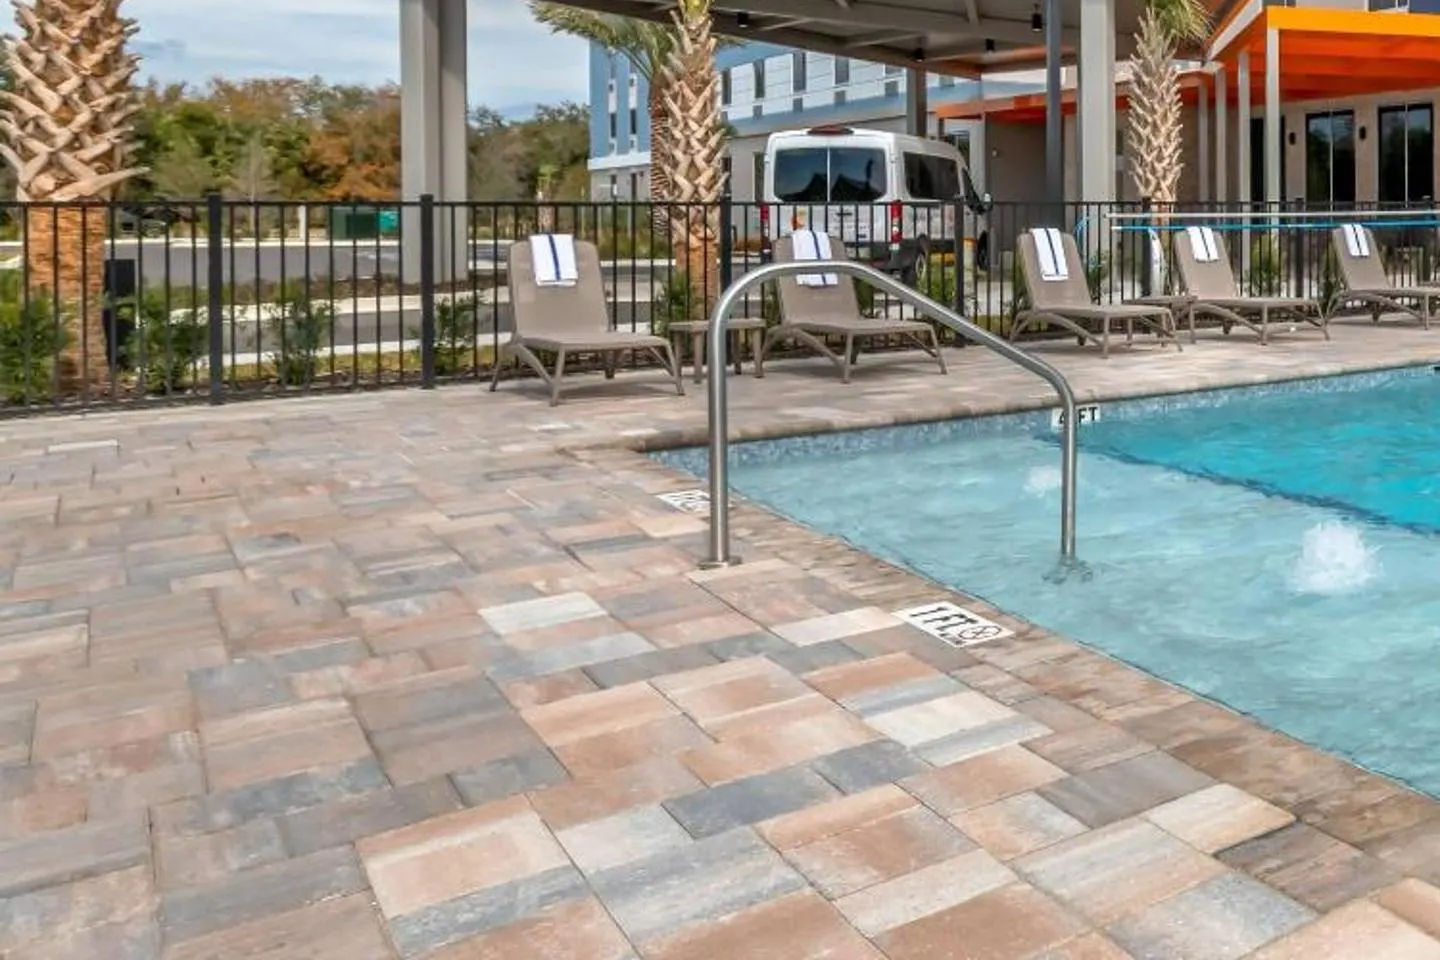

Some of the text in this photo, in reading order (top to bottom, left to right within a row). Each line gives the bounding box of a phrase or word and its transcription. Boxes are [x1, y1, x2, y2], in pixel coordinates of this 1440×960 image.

[1078, 406, 1098, 424] FT
[909, 606, 979, 632] 1 FT
